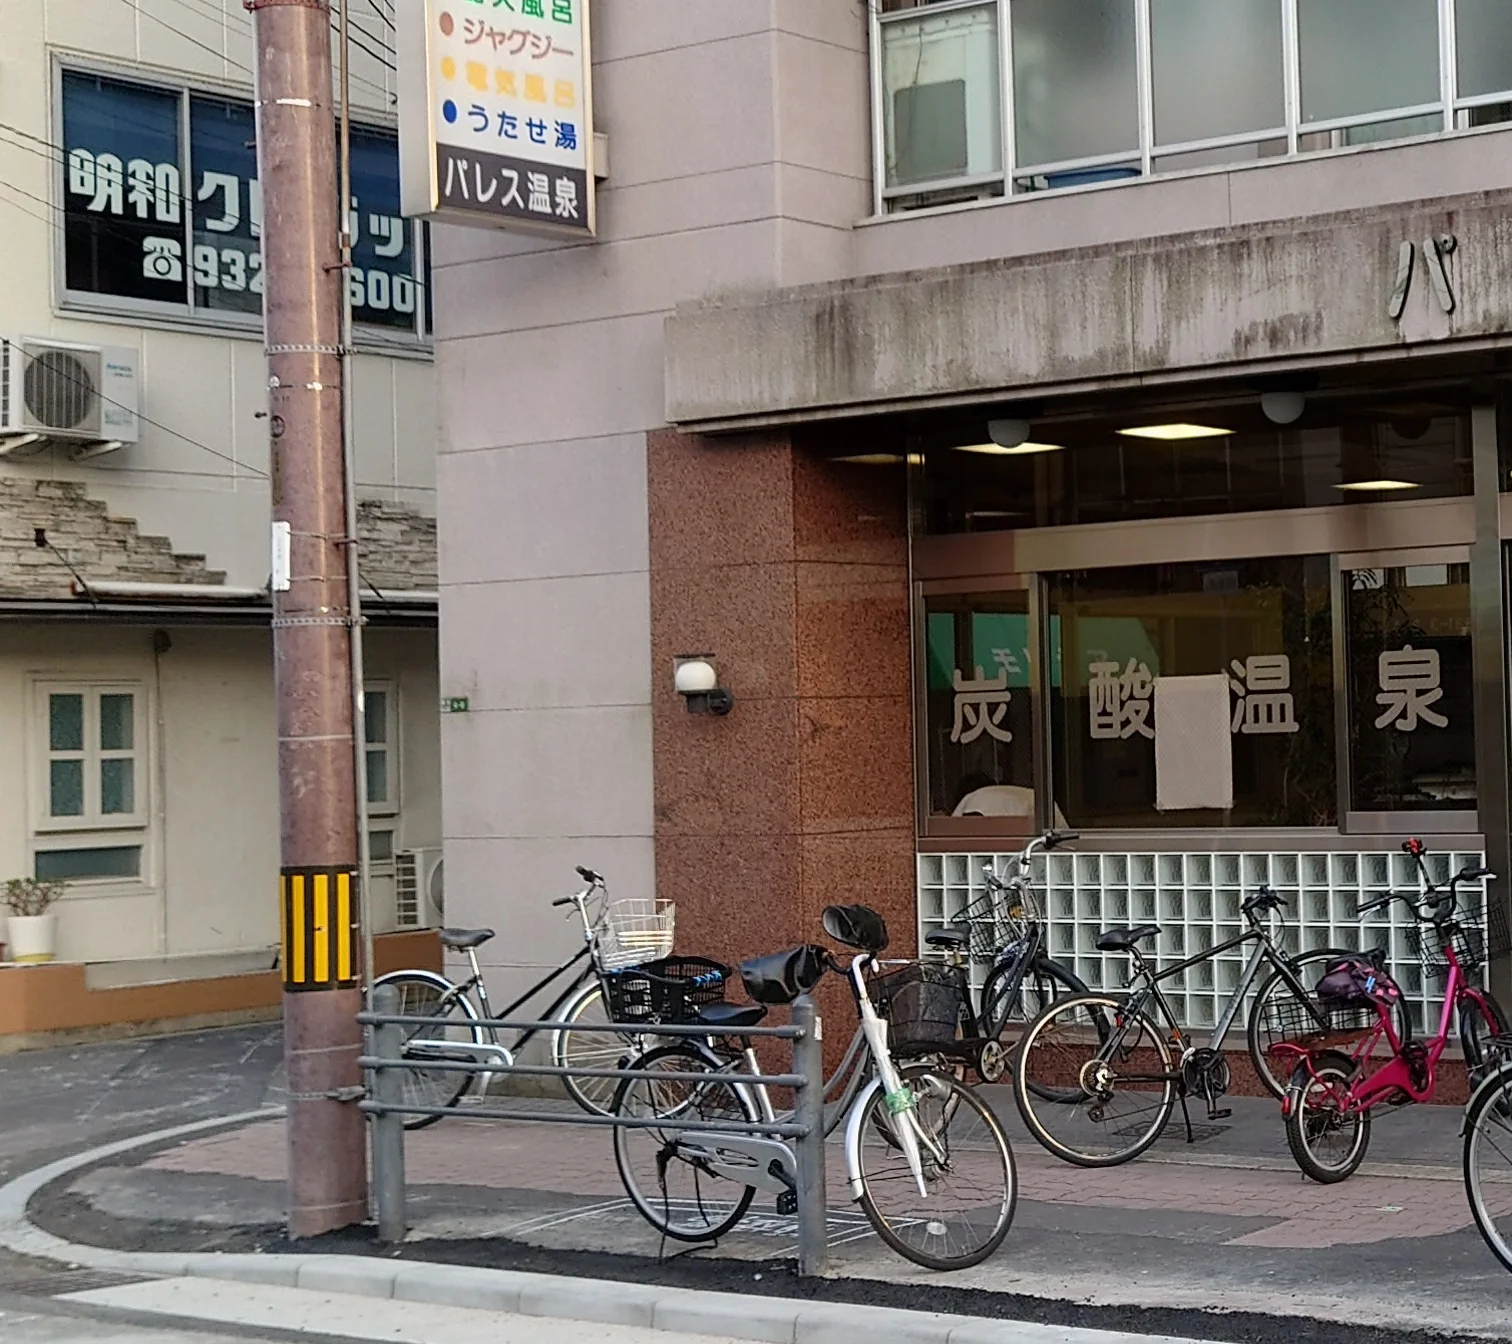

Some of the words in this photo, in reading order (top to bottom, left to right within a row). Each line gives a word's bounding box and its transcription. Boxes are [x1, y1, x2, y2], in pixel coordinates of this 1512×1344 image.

[463, 18, 574, 60] ジャグジー
[468, 104, 577, 151] うたせ湯
[444, 156, 579, 219] パレス温泉
[950, 646, 1448, 744] 炭酸温泉
